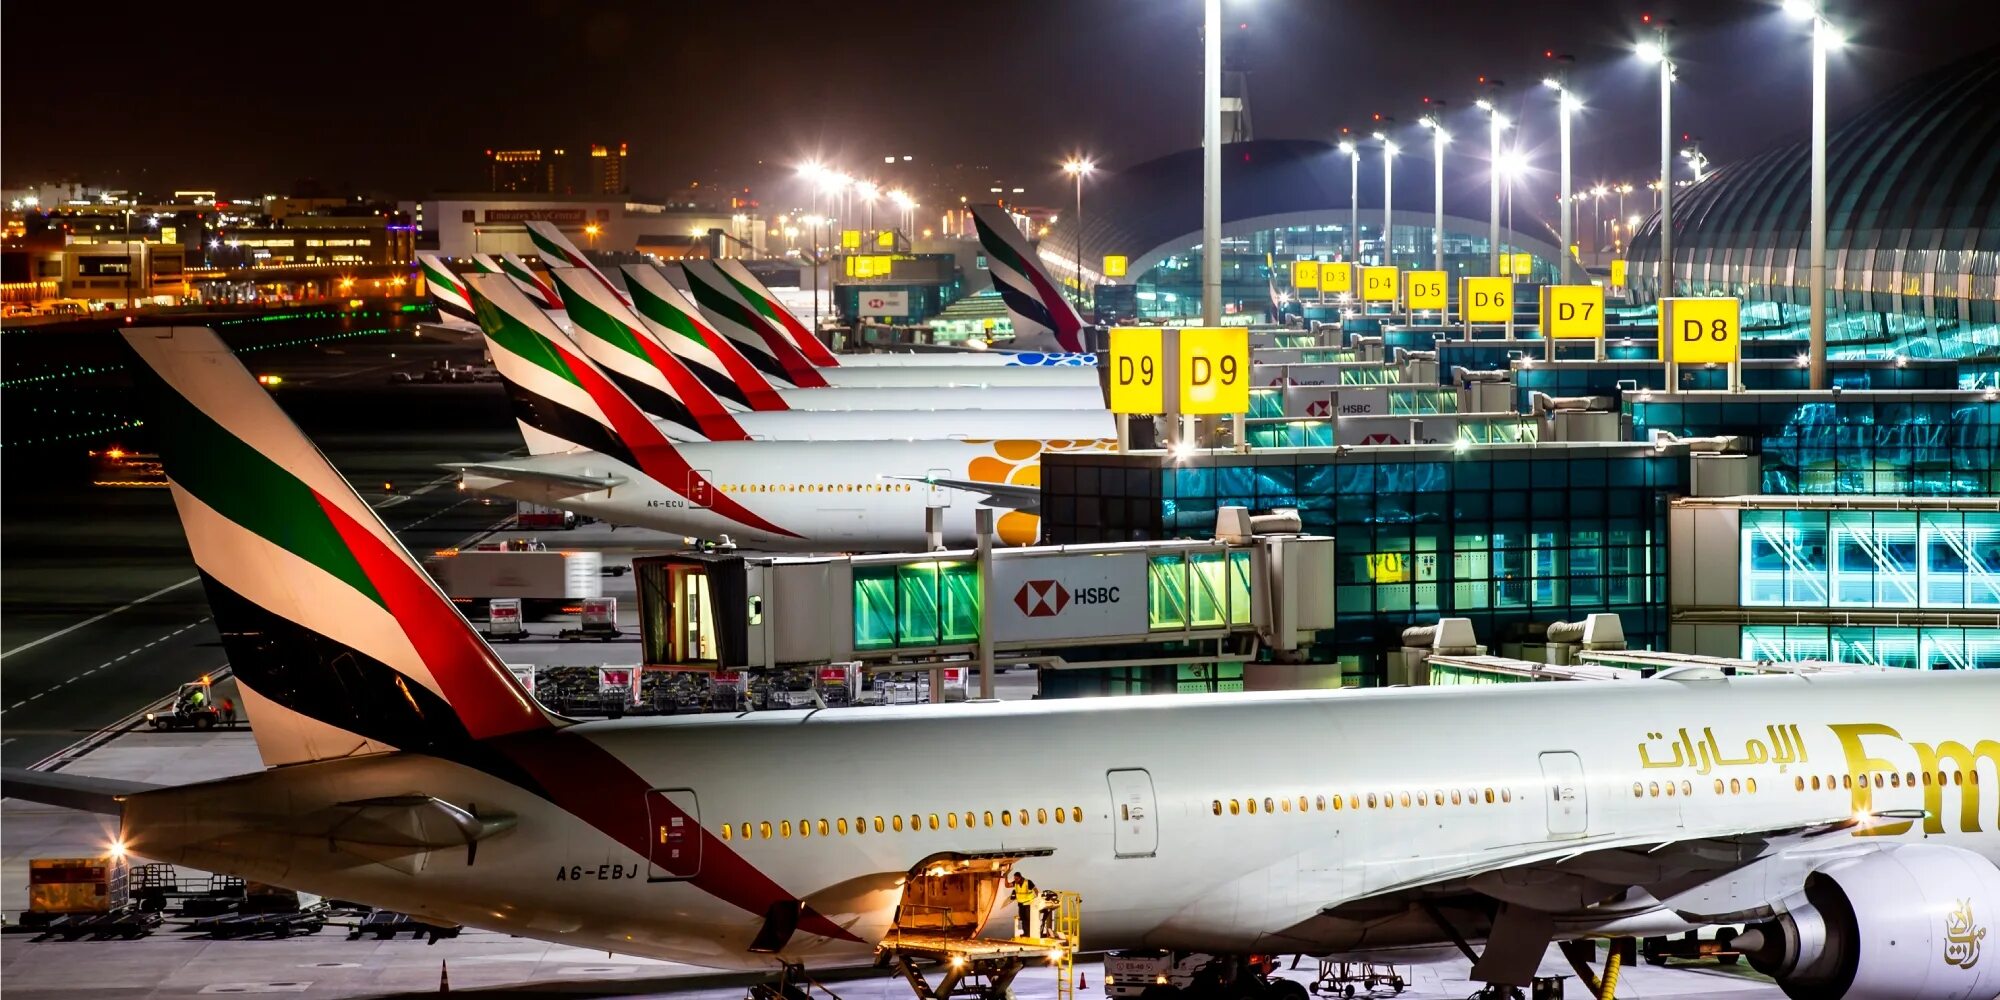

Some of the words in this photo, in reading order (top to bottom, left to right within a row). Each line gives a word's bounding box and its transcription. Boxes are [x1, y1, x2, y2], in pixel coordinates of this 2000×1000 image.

[1343, 404, 1371, 413] HSBC
[647, 500, 684, 508] A6-ECU
[1074, 586, 1120, 605] HSBC
[1638, 724, 1809, 775] الإمارات
[556, 863, 638, 881] A6-EBJ
